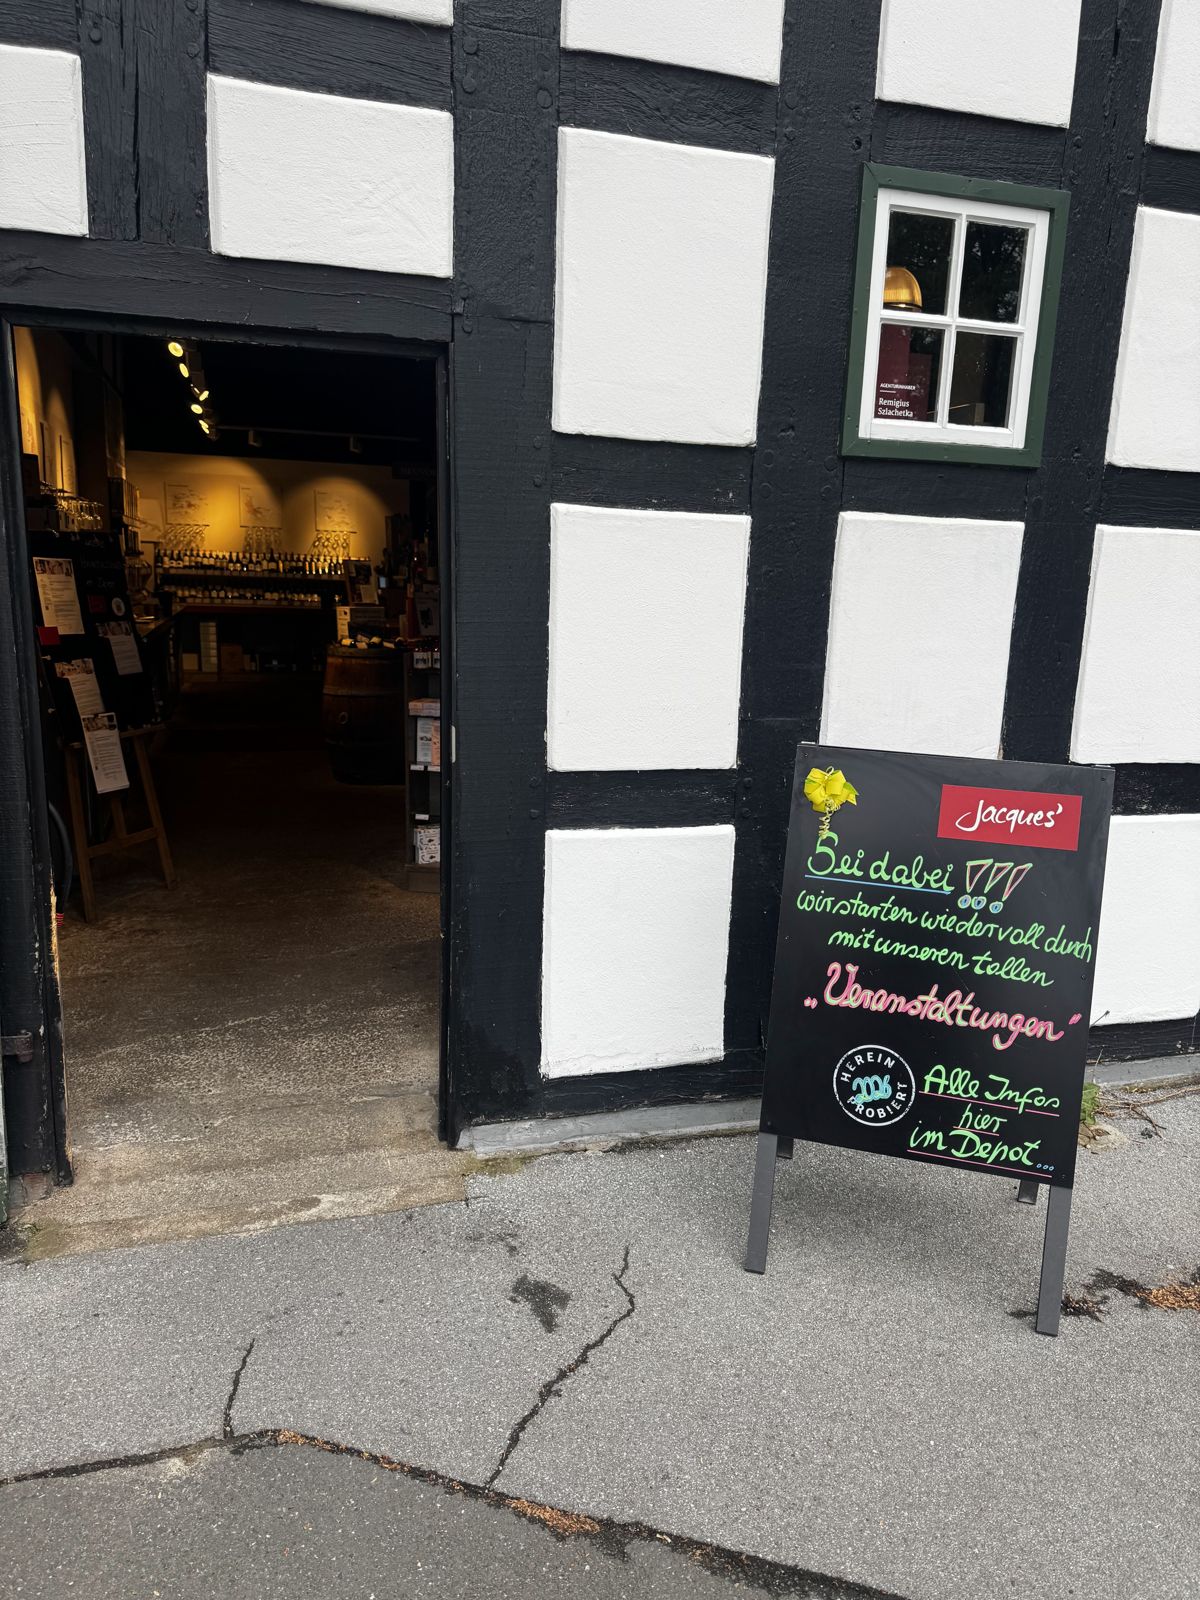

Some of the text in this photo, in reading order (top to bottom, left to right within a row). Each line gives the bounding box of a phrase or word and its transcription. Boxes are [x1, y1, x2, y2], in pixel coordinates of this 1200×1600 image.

[877, 408, 914, 417] Szlachetka
[878, 398, 910, 408] Remigius
[955, 799, 1063, 833] Jacques'
[807, 831, 864, 876] Sei
[869, 850, 955, 892] dabei
[796, 889, 1092, 963] wir starten wieder voll durch
[827, 927, 1055, 987] mit unseren tollen
[840, 1051, 895, 1083] HEREIN
[923, 1064, 1060, 1114] Alle Infos
[958, 1102, 1008, 1132] hier
[909, 1120, 948, 1151] im
